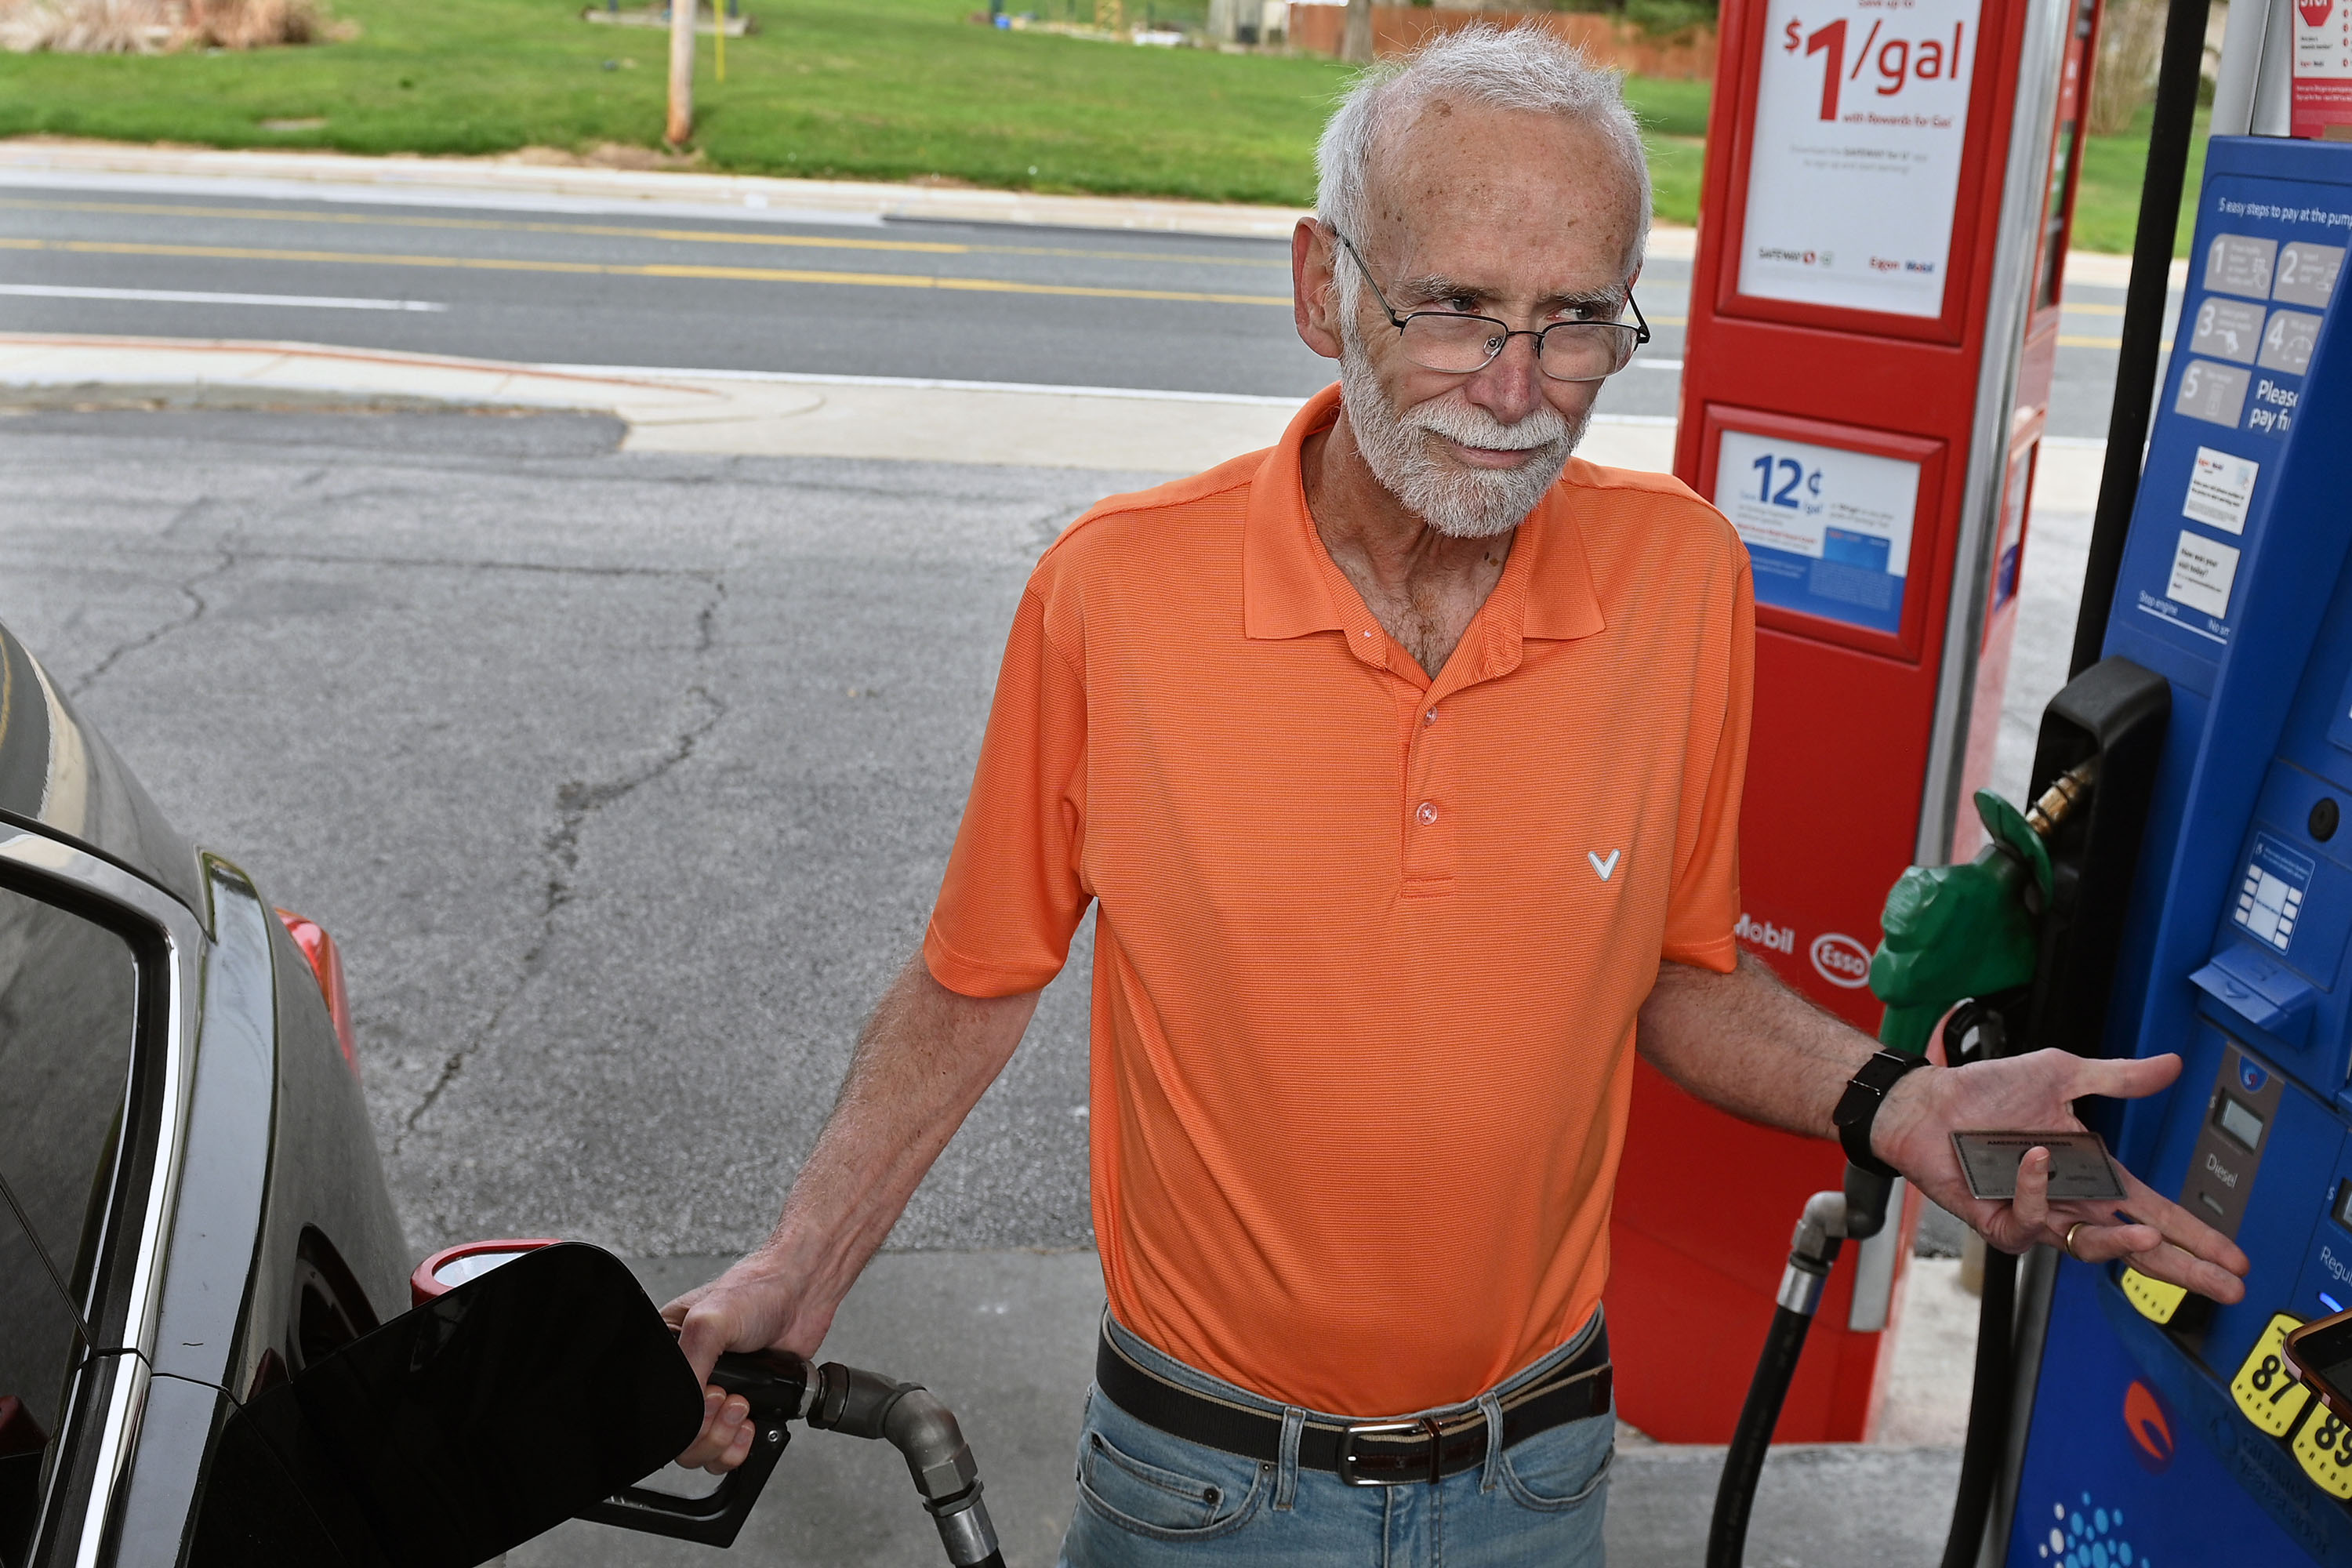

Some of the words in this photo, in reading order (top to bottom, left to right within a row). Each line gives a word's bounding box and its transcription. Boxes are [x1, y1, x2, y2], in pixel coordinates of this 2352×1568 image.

[1784, 16, 1963, 121] $1/gal
[2219, 198, 2227, 212] 5
[2227, 201, 2246, 217] easy
[2246, 203, 2270, 219] steps
[2272, 205, 2281, 218] to
[2281, 208, 2299, 223] pay
[2300, 209, 2310, 222] at
[2311, 208, 2325, 223] the
[2212, 241, 2225, 274] 1
[2281, 250, 2298, 284] 2
[2198, 304, 2216, 336] 3
[2268, 318, 2285, 352] 4
[2184, 367, 2201, 399] 5
[2249, 408, 2277, 433] pay
[1734, 913, 1795, 954] Mobil
[1820, 943, 1866, 975] Esso
[2205, 1152, 2238, 1189] Diesel
[2252, 1354, 2299, 1405] 87
[2314, 1413, 2352, 1468] 89
